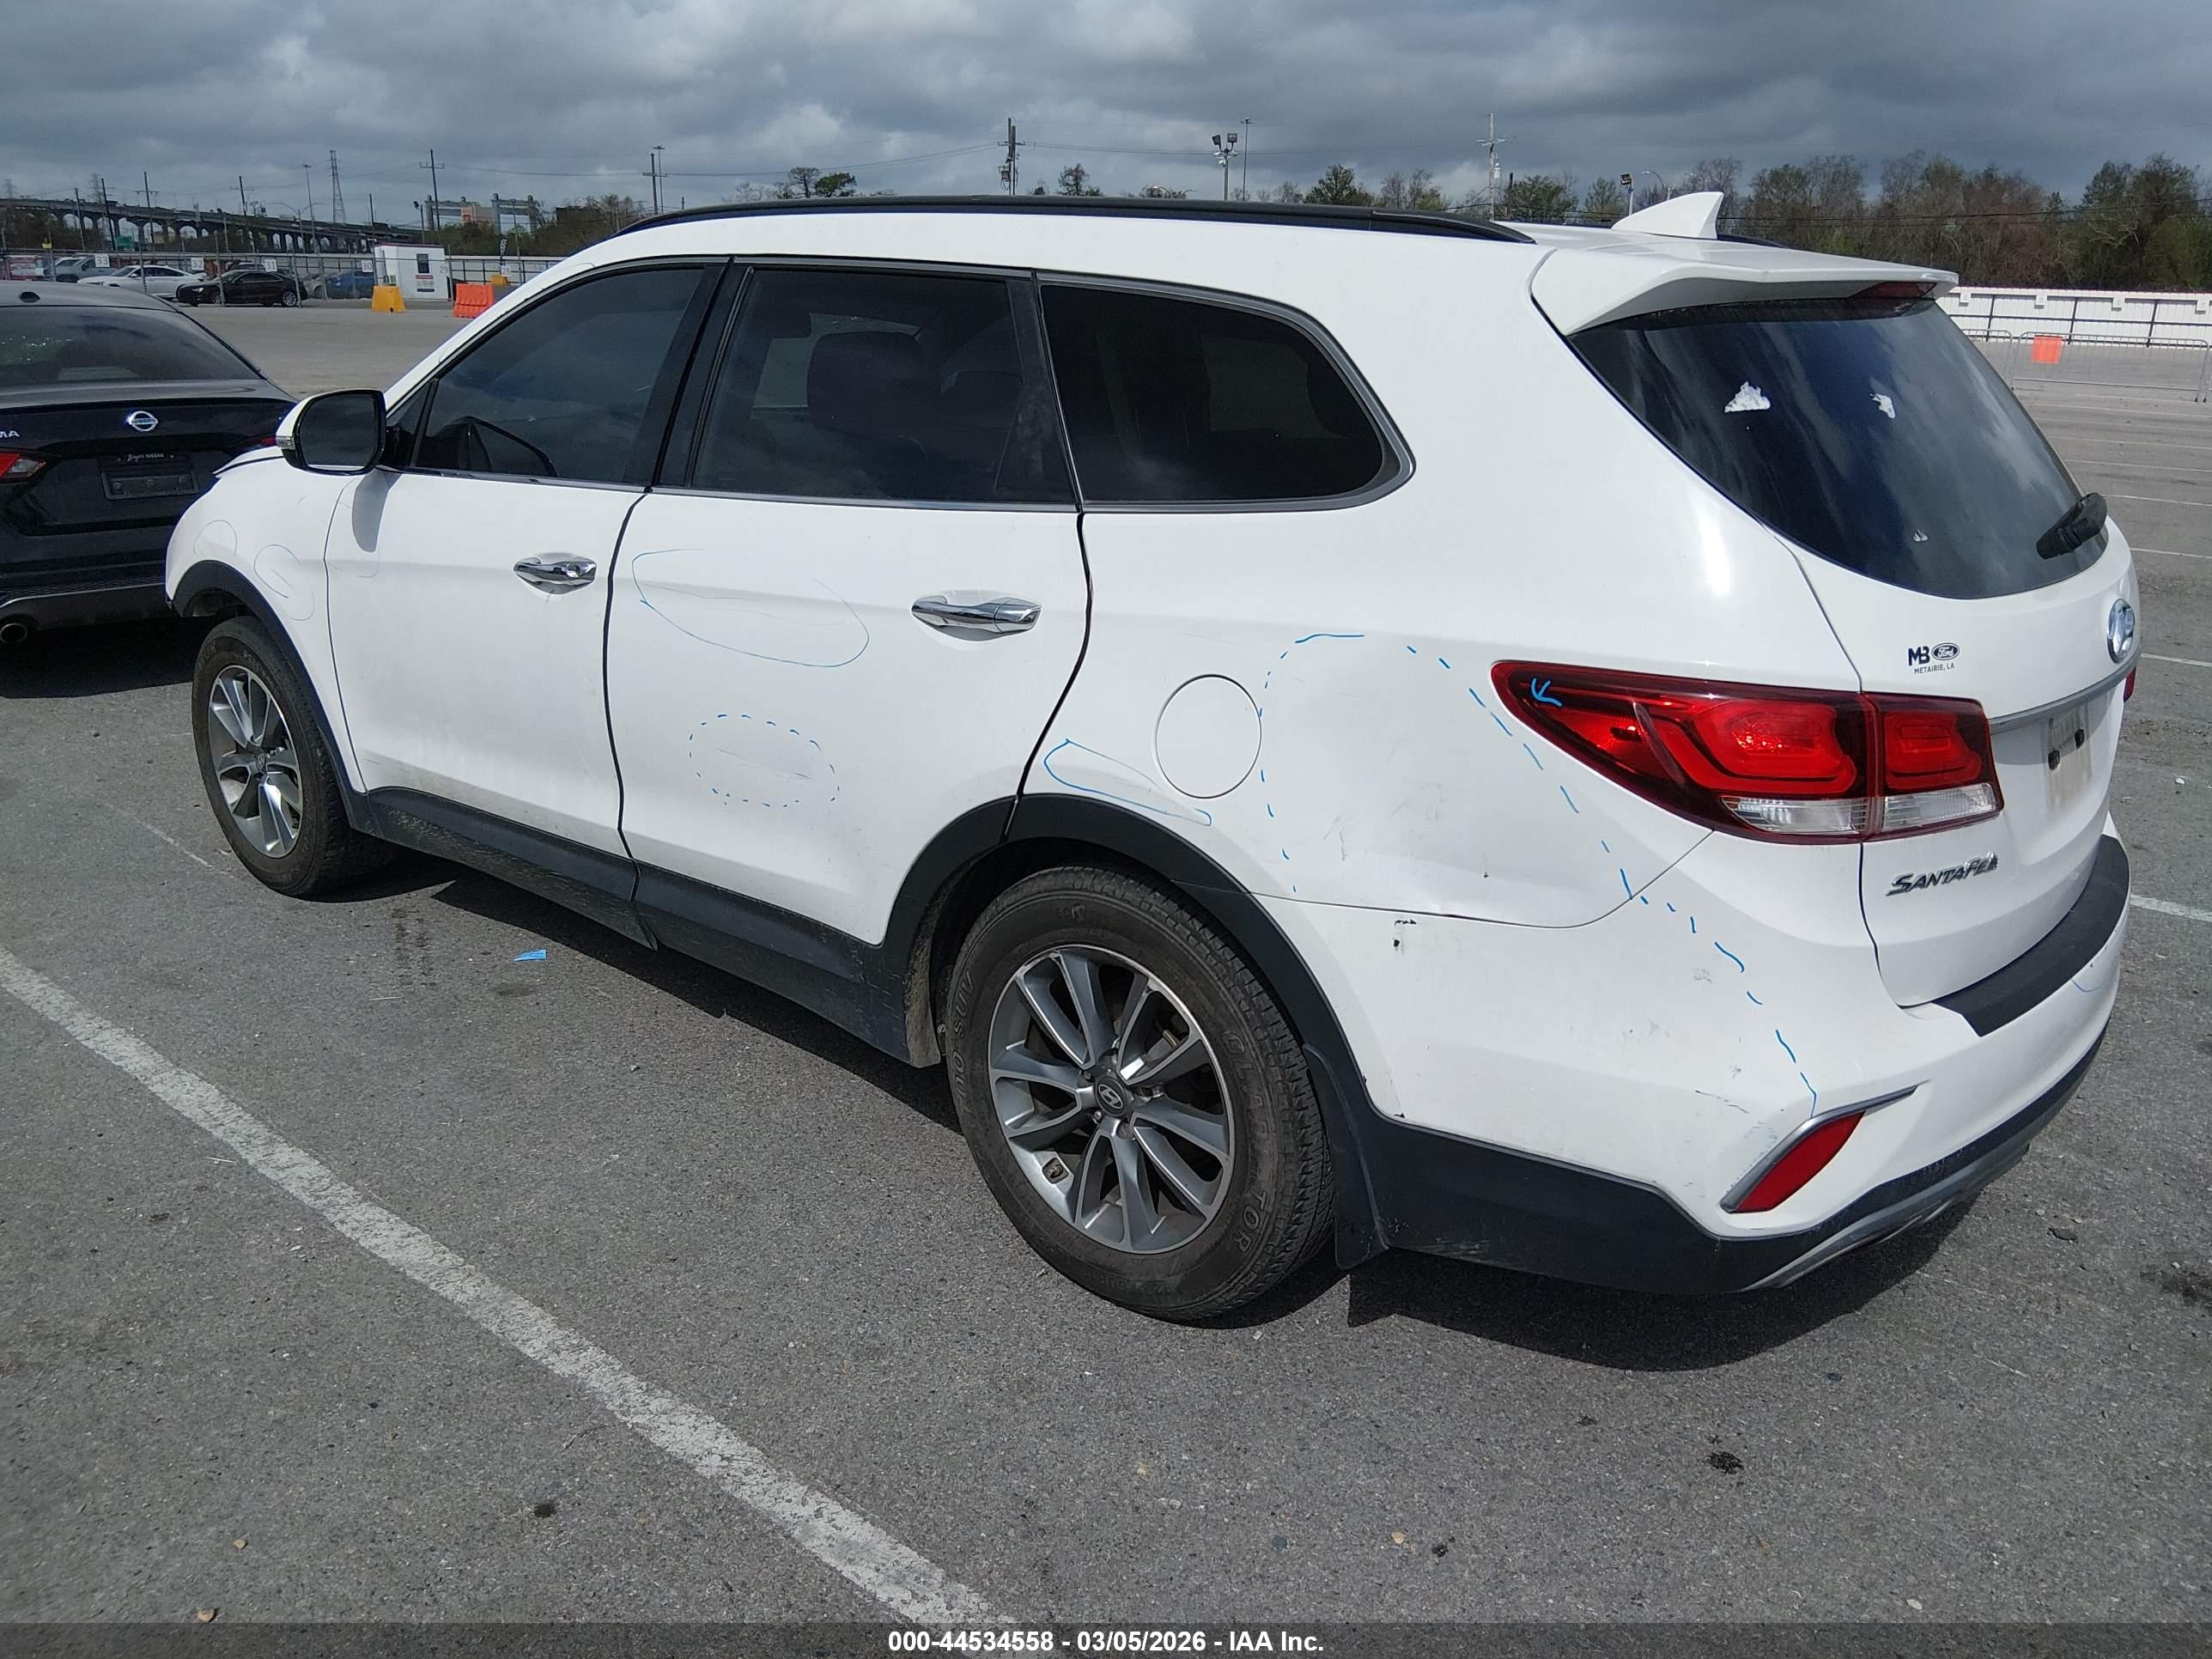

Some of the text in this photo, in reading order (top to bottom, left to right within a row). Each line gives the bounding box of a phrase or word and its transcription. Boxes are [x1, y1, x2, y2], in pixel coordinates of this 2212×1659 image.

[96, 255, 108, 265] 33
[192, 260, 204, 269] 32
[266, 261, 276, 270] 31
[362, 261, 372, 270] 30
[439, 265, 448, 274] 29
[1907, 645, 1931, 667] MB
[1913, 664, 1946, 675] METAIRIE,
